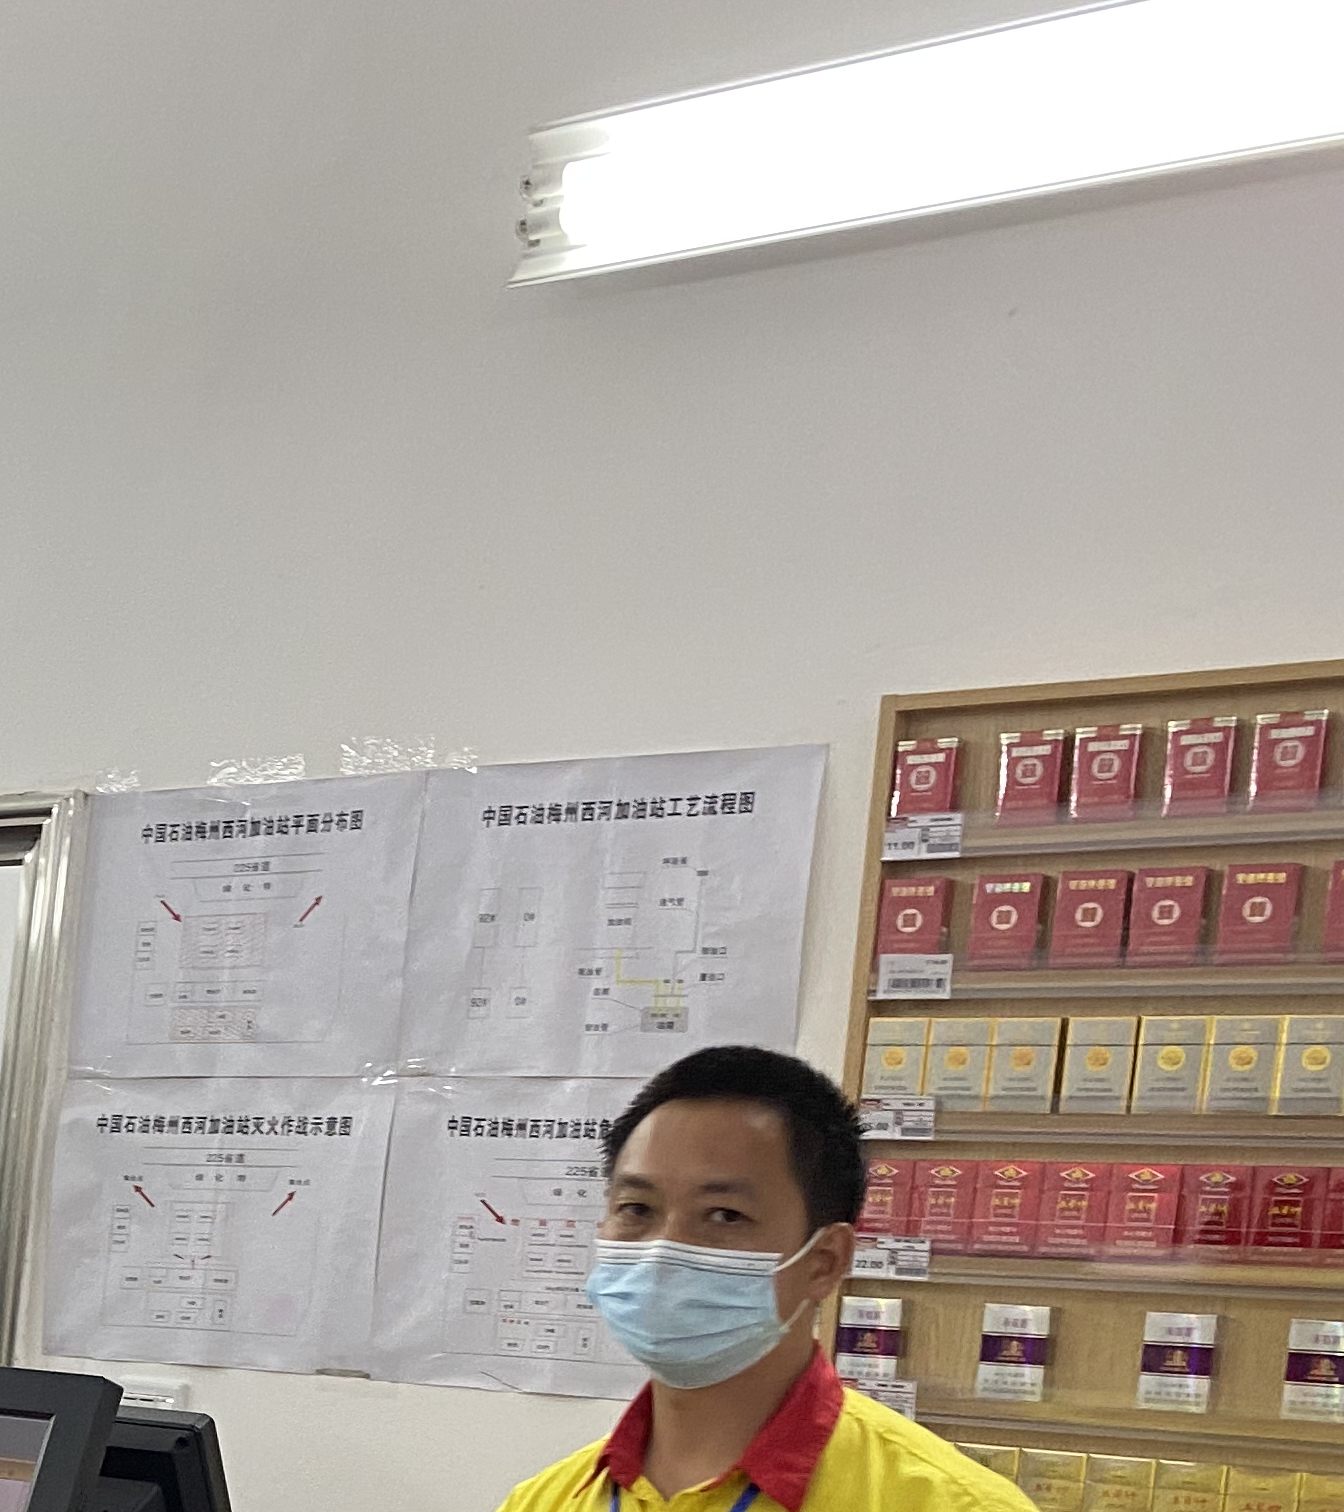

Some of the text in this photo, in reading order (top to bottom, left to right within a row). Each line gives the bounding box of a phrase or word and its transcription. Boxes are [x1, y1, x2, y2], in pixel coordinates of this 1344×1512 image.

[140, 809, 364, 844] 中国石油梅州西河加油站平面分布图
[481, 791, 756, 828] 中国石油梅州西河加油站工艺流程图
[95, 1113, 353, 1137] 中国石油梅州西河加油站灭火作战示意图
